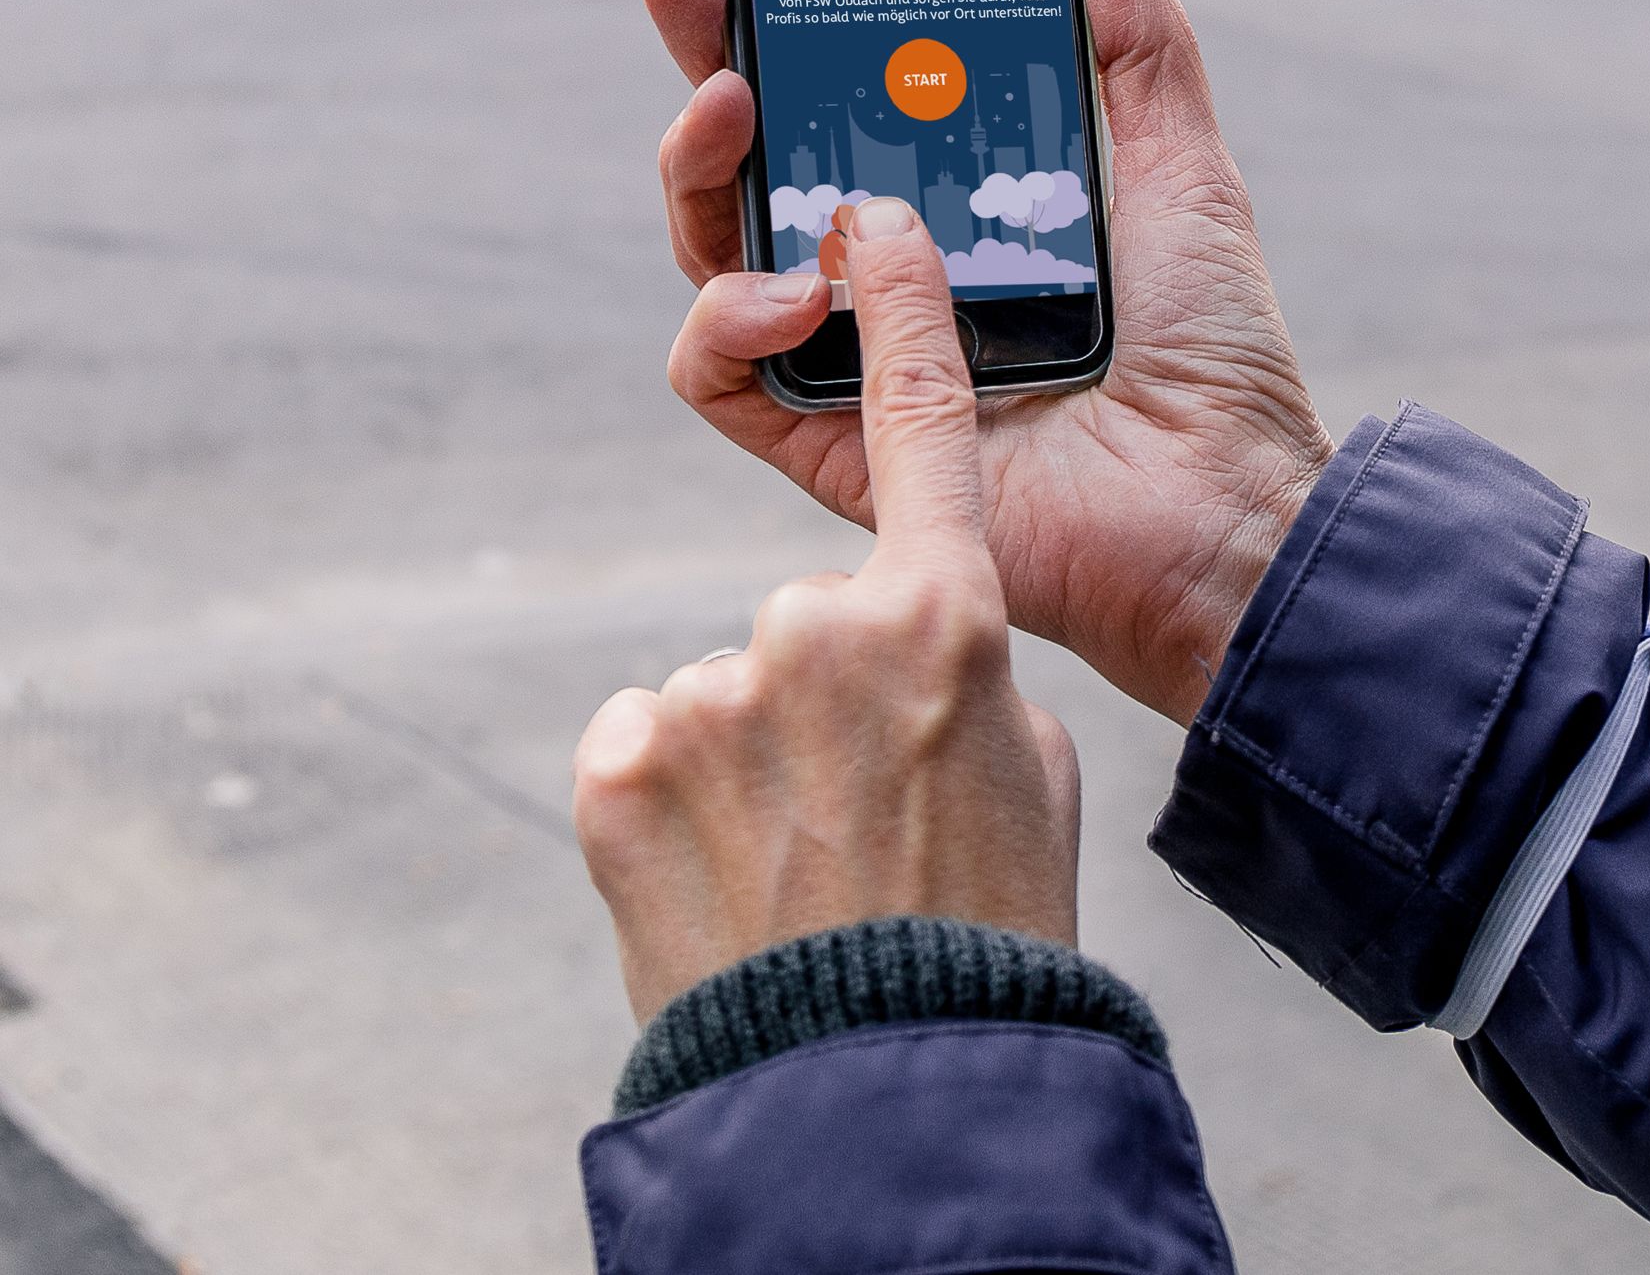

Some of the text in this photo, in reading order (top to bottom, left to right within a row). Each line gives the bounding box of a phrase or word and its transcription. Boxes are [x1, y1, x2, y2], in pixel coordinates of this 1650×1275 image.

[766, 6, 1062, 25] Profis so bald wie möglich vor Ort unterstützen!
[903, 72, 948, 86] START
